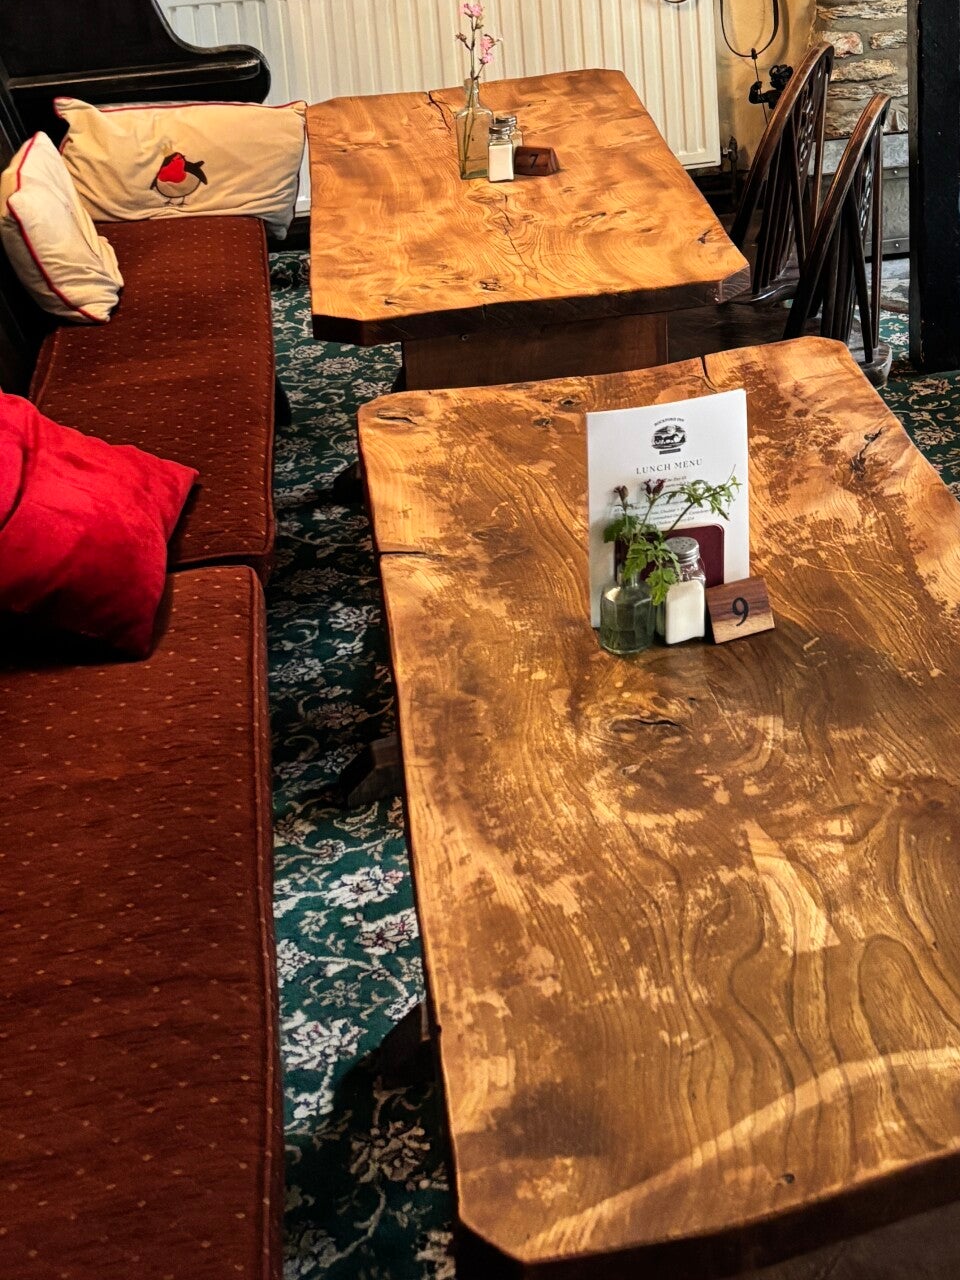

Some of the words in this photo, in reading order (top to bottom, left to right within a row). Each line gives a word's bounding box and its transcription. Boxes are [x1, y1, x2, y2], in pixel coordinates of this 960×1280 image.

[529, 153, 539, 169] 7
[636, 463, 671, 475] LUNCH
[674, 459, 703, 470] MENU
[732, 597, 749, 627] 9
